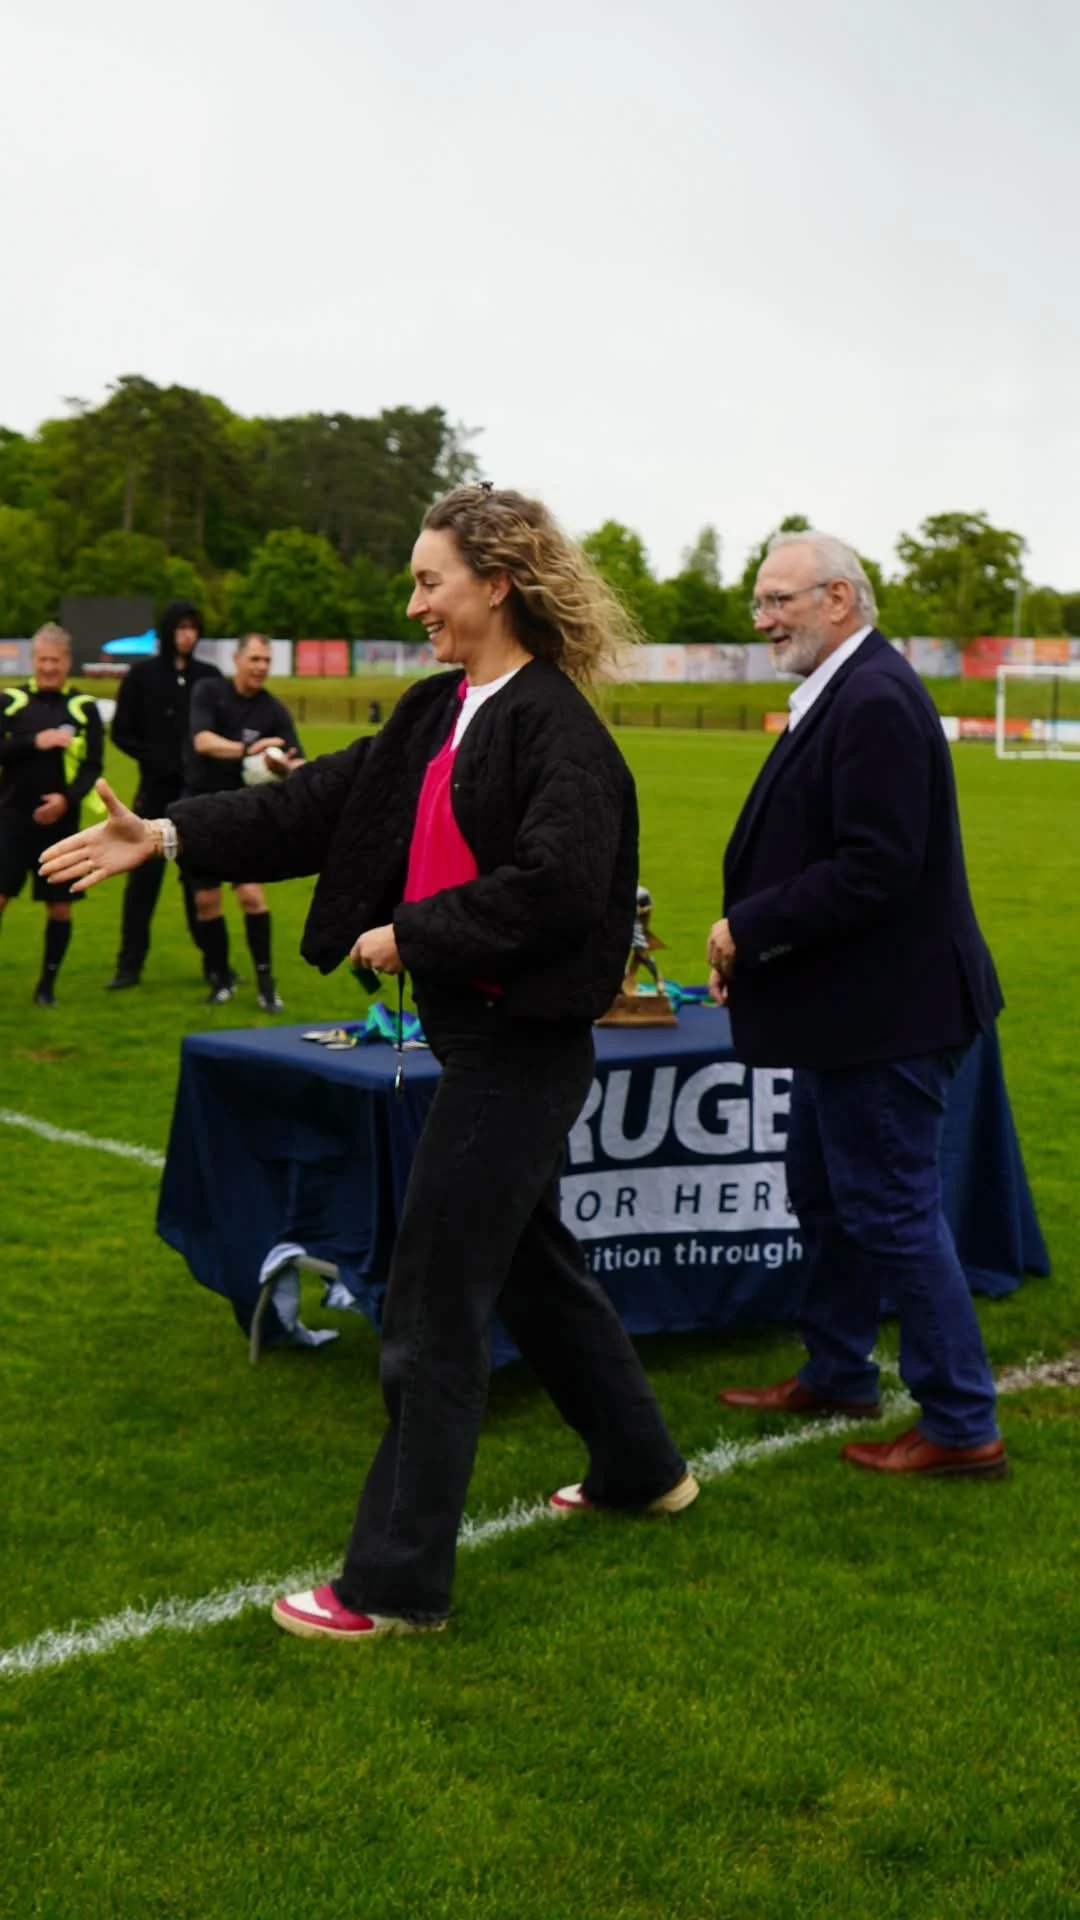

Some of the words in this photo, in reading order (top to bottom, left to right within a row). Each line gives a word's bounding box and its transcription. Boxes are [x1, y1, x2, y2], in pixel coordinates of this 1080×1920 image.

[561, 1187, 638, 1222] OR
[674, 1181, 798, 1216] HER
[674, 1237, 804, 1270] through
